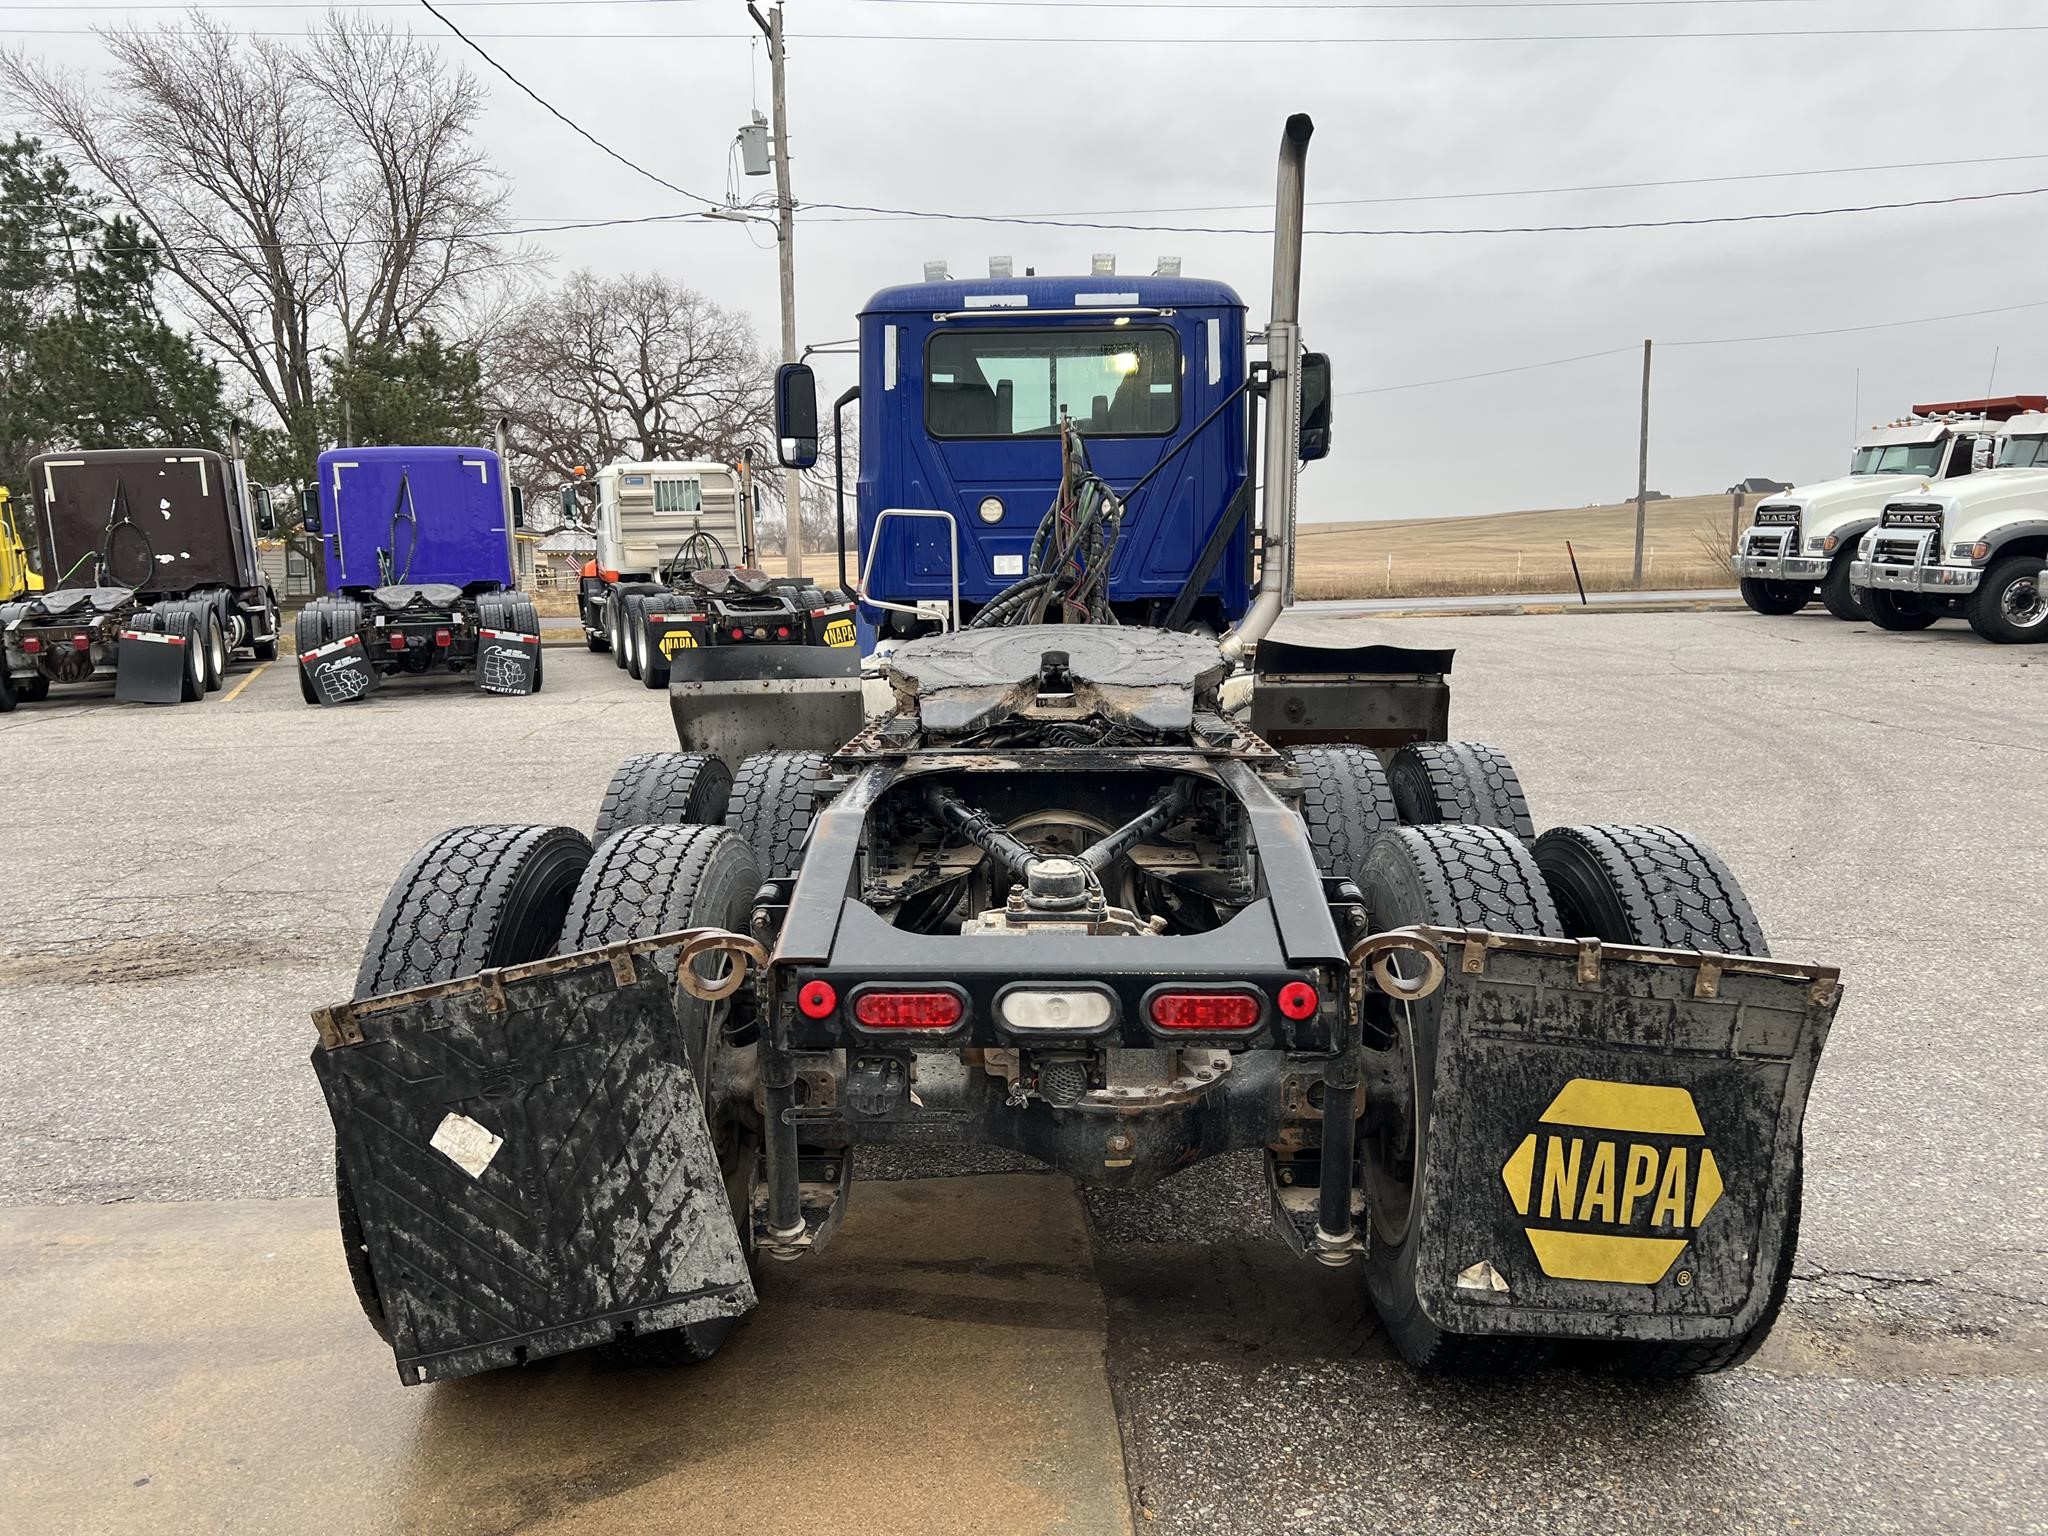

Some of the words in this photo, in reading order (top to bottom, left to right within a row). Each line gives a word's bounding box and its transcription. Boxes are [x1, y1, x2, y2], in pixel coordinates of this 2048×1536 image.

[1888, 514, 1937, 523] MACK
[828, 625, 855, 645] NAPA
[1539, 1135, 1687, 1228] NAPA
